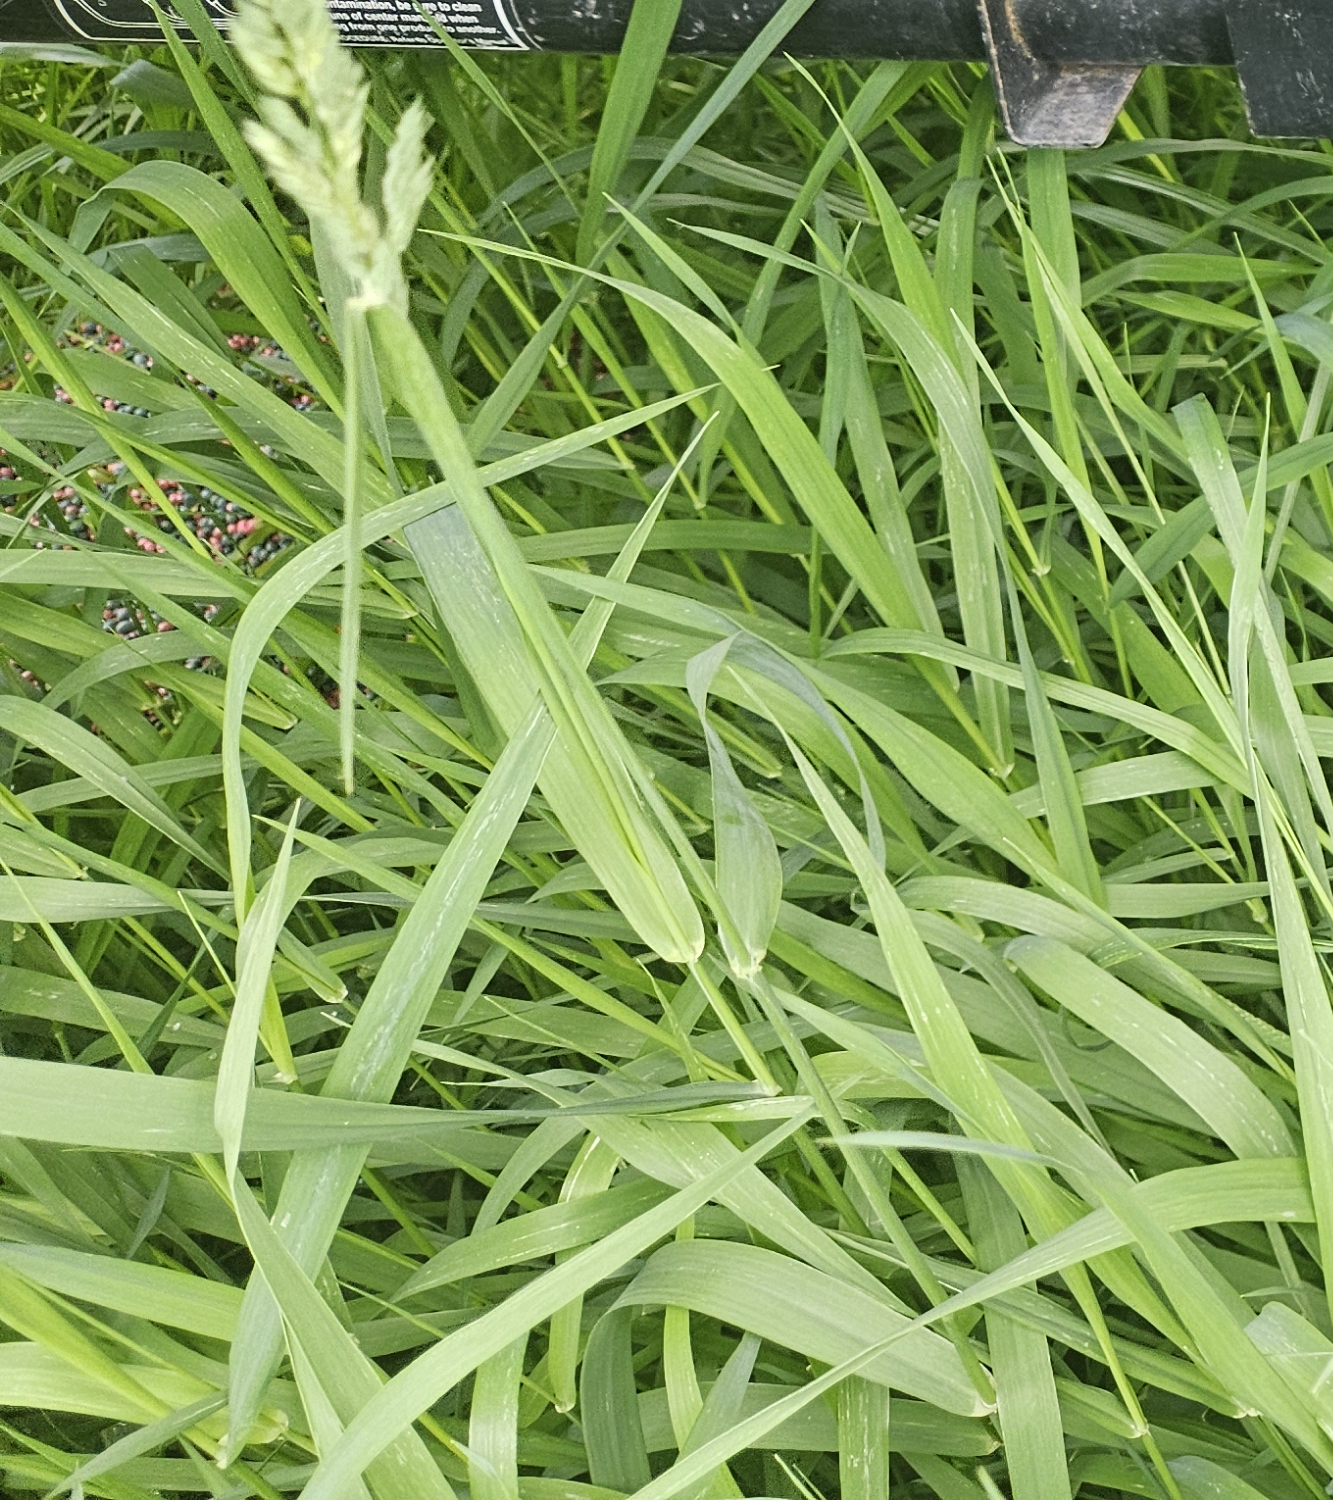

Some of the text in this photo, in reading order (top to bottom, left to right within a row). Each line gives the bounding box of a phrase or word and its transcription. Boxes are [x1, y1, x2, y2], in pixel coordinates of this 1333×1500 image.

[325, 0, 396, 11] ntamination,
[396, 0, 412, 11] be
[437, 1, 451, 12] to
[452, 1, 483, 13] clean
[351, 10, 363, 21] of
